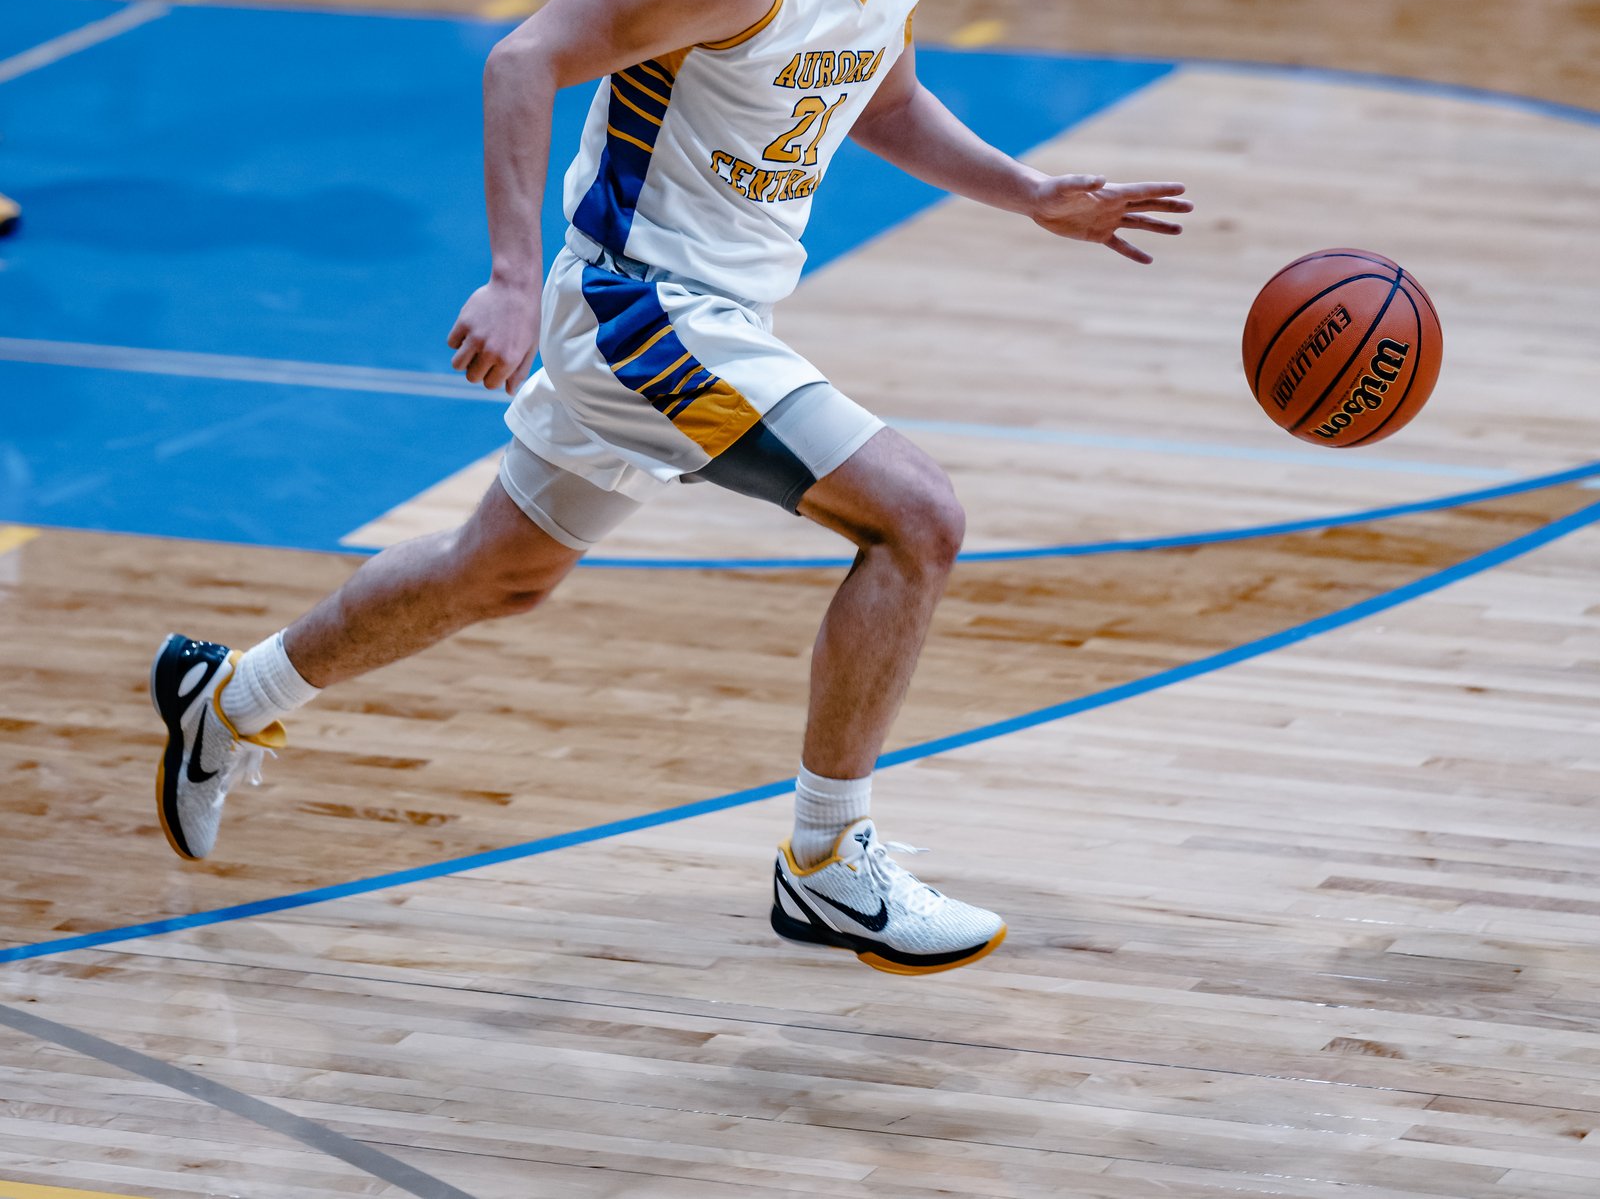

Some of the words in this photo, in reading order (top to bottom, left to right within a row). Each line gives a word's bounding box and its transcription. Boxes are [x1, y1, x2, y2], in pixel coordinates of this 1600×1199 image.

[773, 47, 886, 89] AURORA
[762, 93, 847, 166] 21
[1272, 307, 1351, 411] EVOLUTION
[1313, 337, 1410, 438] Wilson
